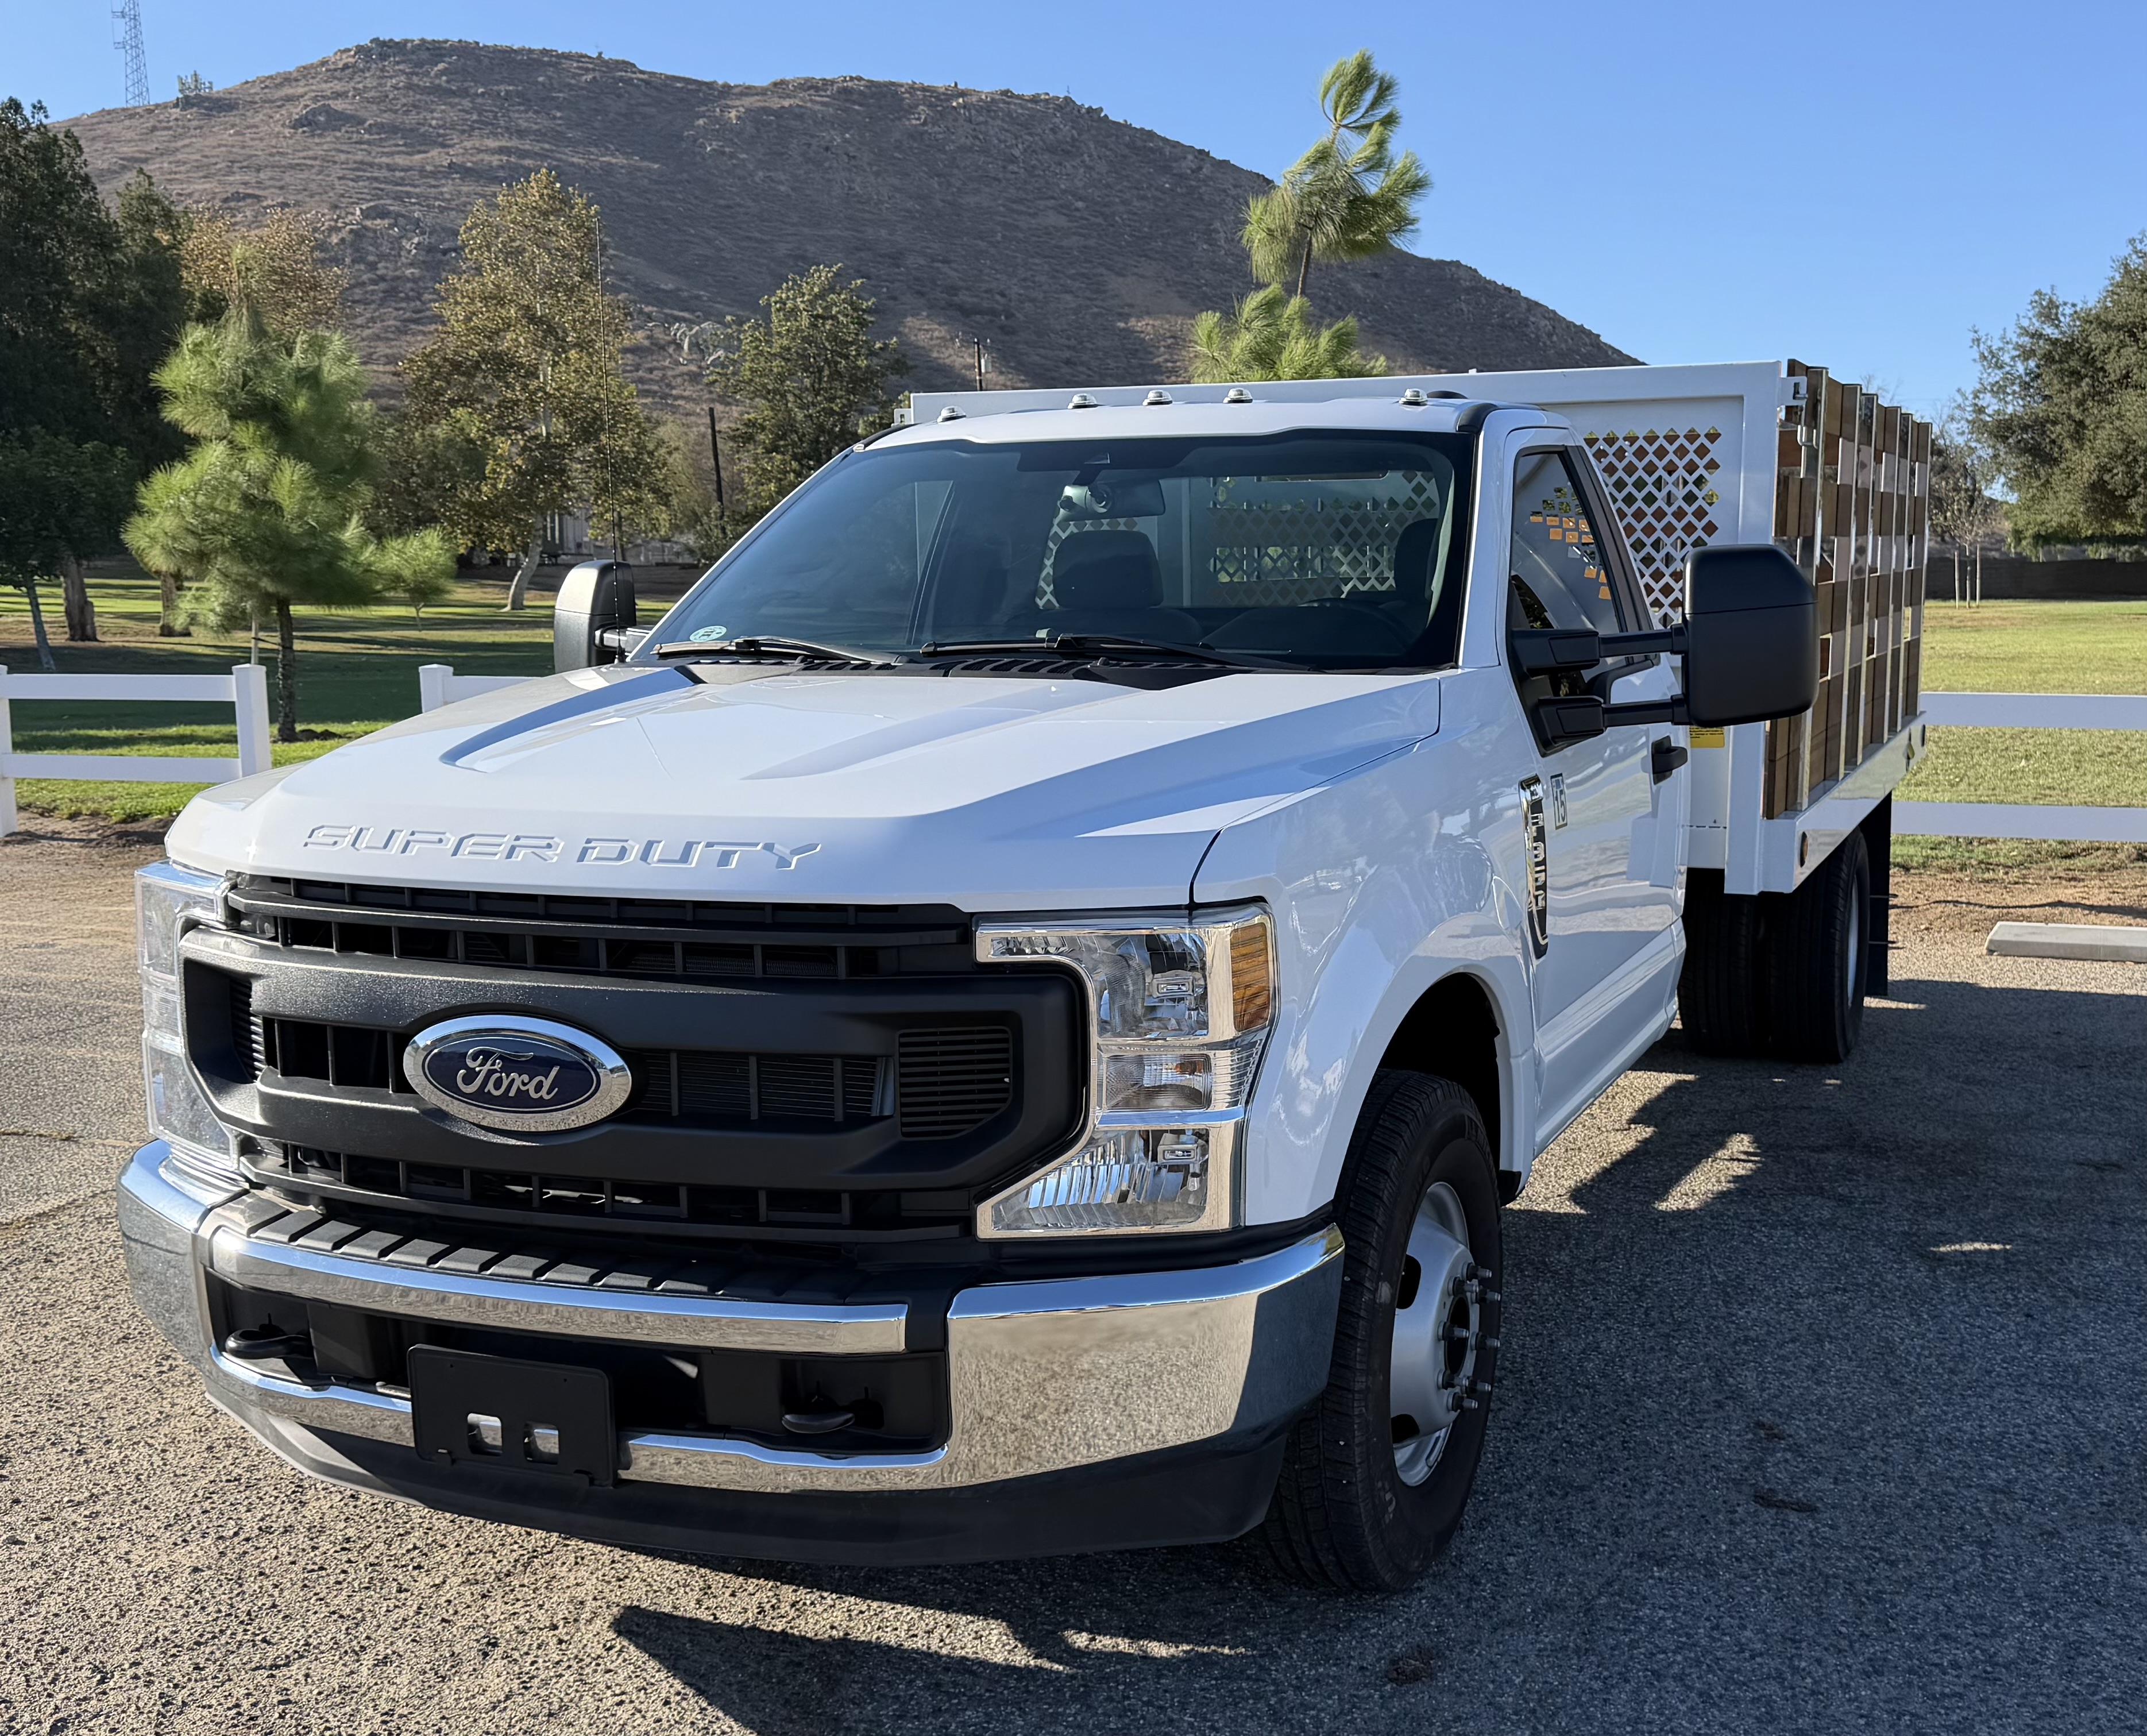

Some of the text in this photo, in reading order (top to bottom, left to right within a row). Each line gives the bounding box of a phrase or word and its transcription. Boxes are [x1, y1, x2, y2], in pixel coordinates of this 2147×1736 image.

[303, 824, 821, 870] SUPER DUTY
[457, 1046, 561, 1100] Ford
